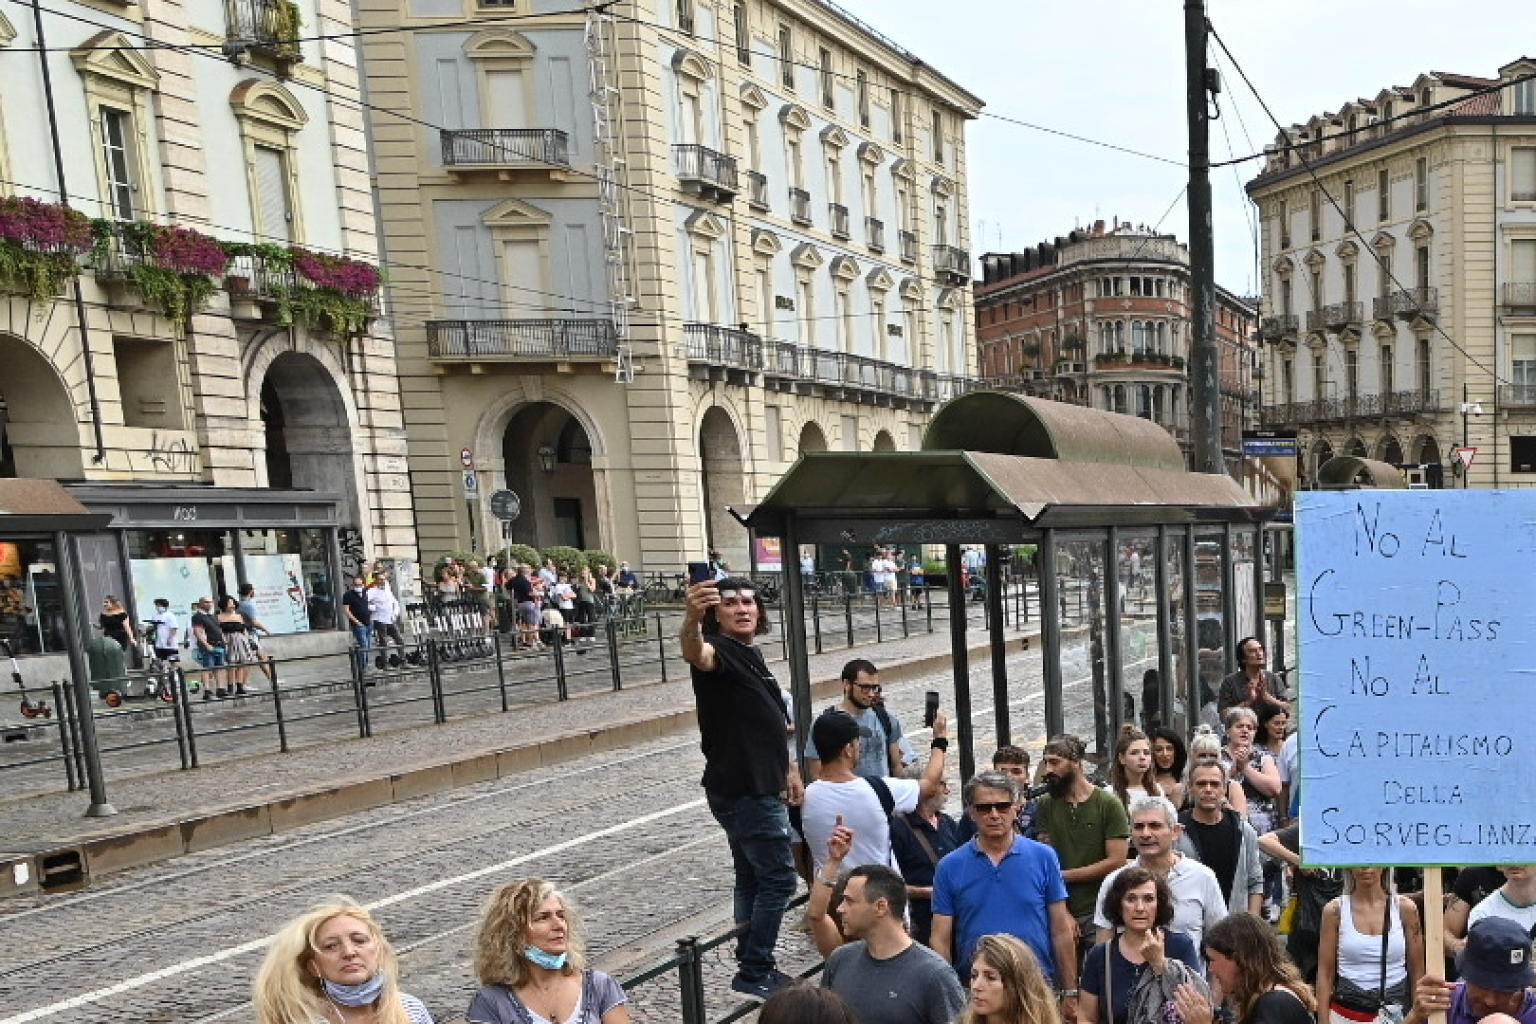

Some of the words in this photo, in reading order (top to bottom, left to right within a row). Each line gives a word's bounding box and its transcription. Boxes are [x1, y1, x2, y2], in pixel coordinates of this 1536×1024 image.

[1309, 567, 1502, 643] GREEN-PASS
[1313, 704, 1514, 759] CAPITALISMO
[1382, 780, 1464, 805] DELLA
